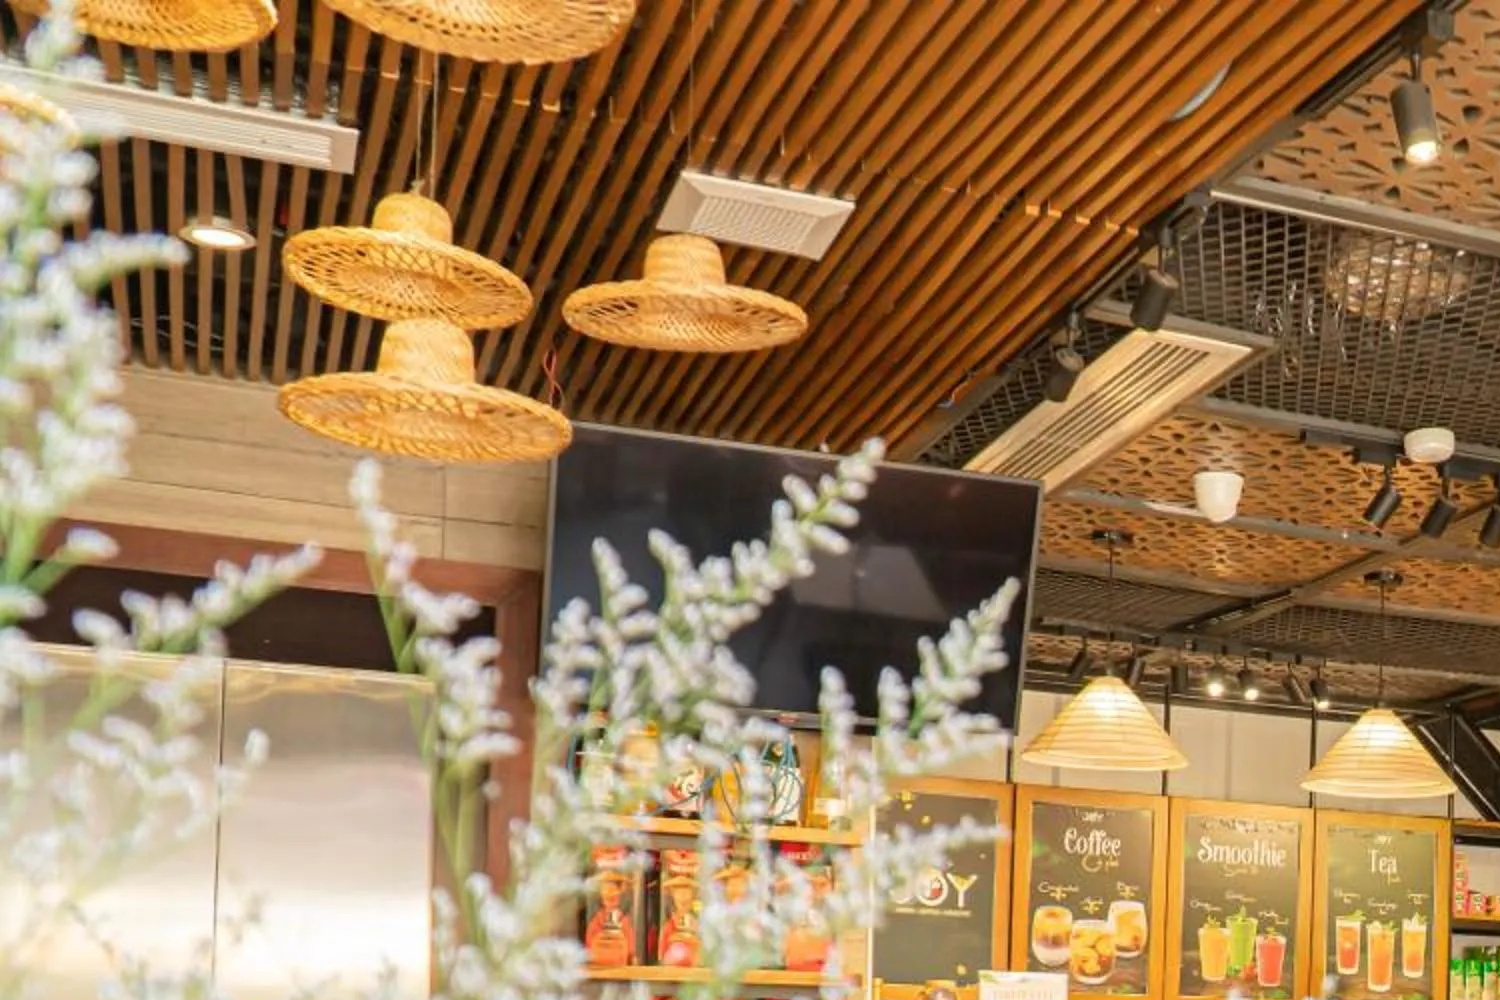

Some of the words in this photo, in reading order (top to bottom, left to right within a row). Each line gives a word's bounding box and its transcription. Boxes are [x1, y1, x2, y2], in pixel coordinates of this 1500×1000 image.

[1063, 827, 1121, 857] Coffee
[1197, 836, 1286, 867] Smoothie
[1367, 849, 1397, 874] Tea
[888, 866, 978, 908] OY
